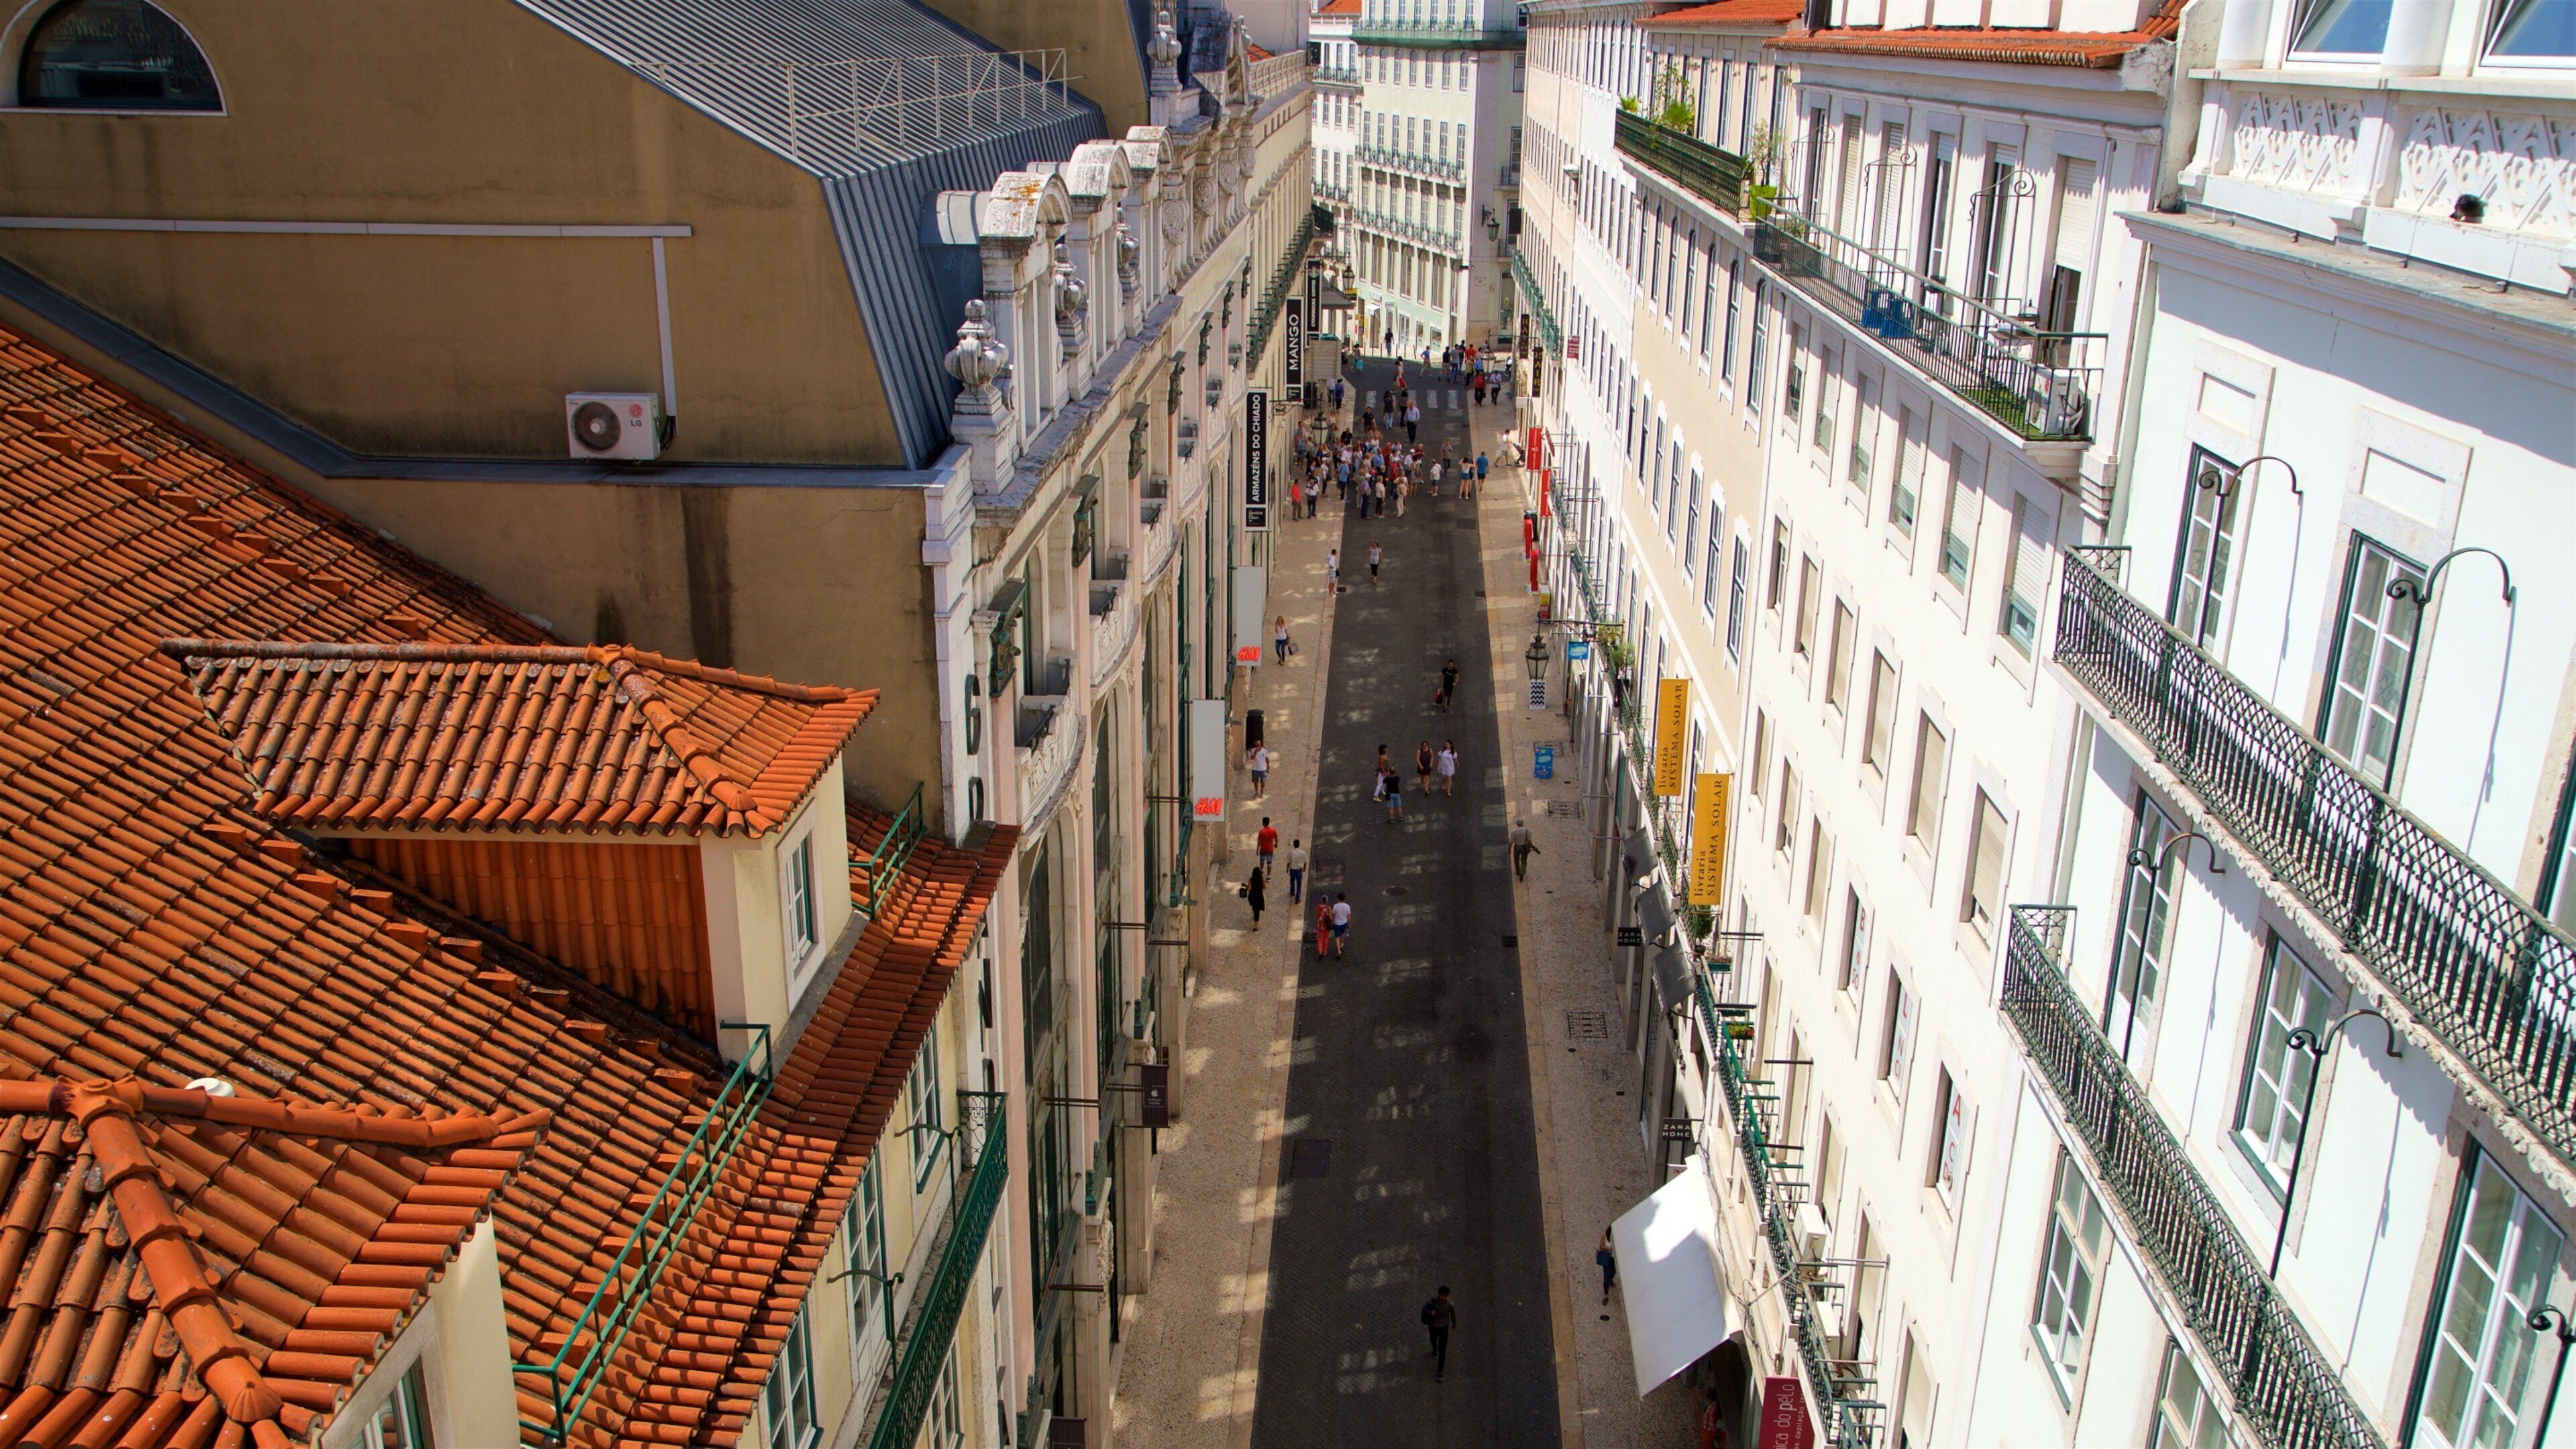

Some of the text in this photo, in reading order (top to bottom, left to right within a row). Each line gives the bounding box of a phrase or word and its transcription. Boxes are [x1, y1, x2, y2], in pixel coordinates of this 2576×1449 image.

[1289, 314, 1299, 370] MANGO
[1252, 394, 1260, 433] CHIADO
[1252, 434, 1260, 449] DO
[1250, 451, 1260, 502] ARMAZÉNS
[1669, 684, 1682, 788] SISTEMA SOLAR
[1658, 747, 1668, 788] livraria
[1195, 797, 1223, 816] H&M
[1707, 780, 1723, 897] SISTEMA SOLAR
[1694, 850, 1706, 896] livraria
[1773, 1413, 1791, 1428] do
[1794, 1406, 1805, 1439] depilação
